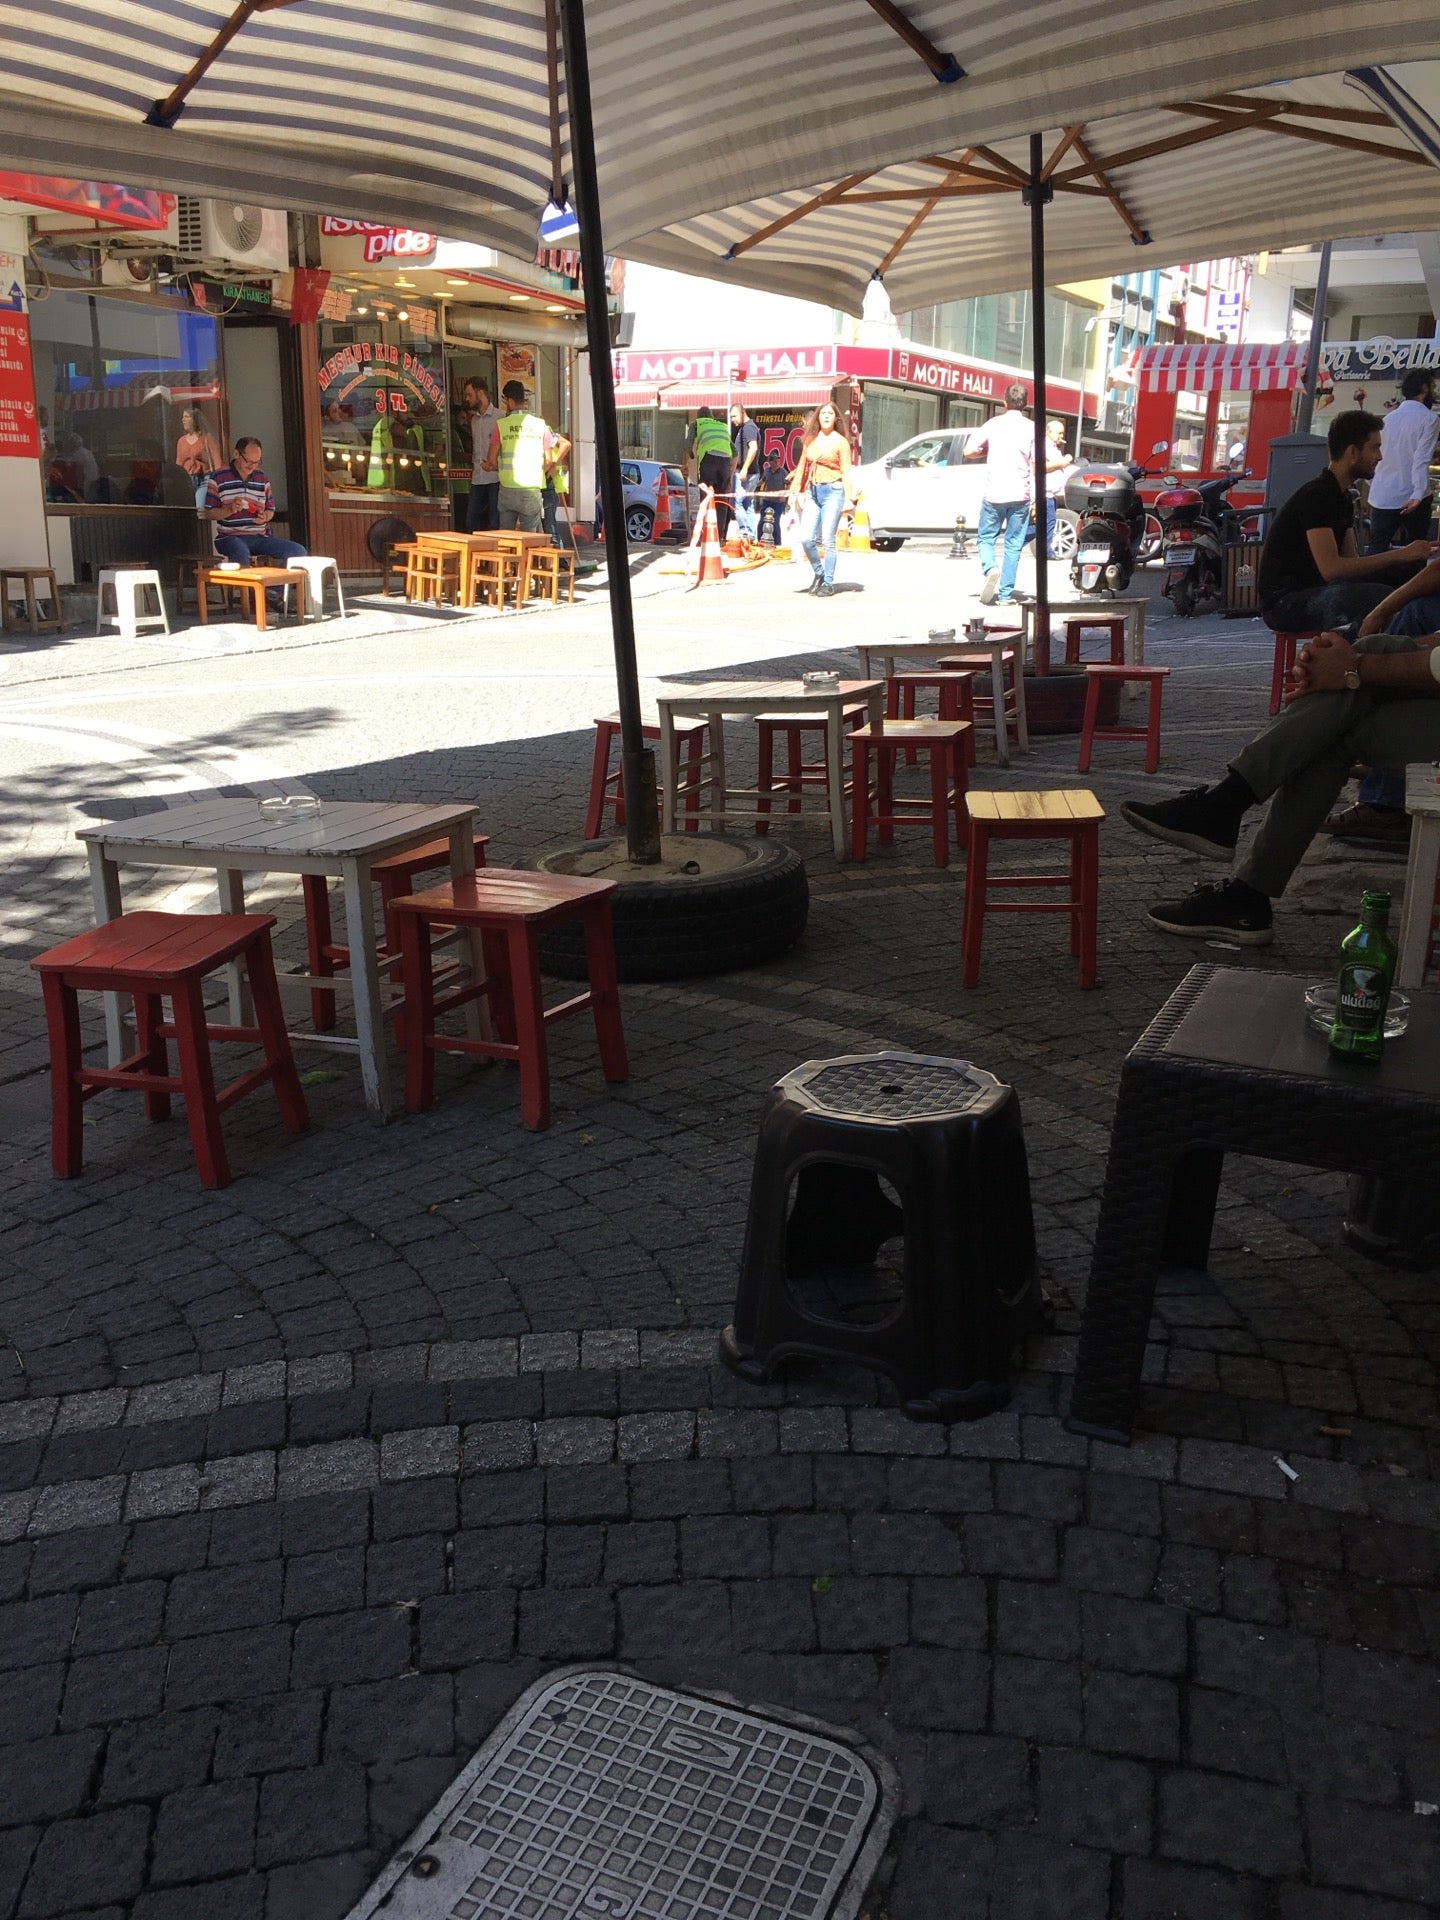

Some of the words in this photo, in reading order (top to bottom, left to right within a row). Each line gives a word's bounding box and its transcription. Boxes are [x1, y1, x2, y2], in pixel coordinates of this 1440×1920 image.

[368, 229, 431, 260] pide
[318, 343, 371, 391] MEŞHUR
[375, 343, 398, 365] KIR
[403, 352, 446, 409] PİDESİ
[639, 351, 740, 380] MOTİF
[751, 350, 823, 378] HALI
[913, 360, 960, 389] MOTİF
[963, 372, 993, 395] HALI
[376, 389, 387, 413] 3
[390, 393, 407, 411] TL
[1341, 994, 1381, 1009] uludağ
